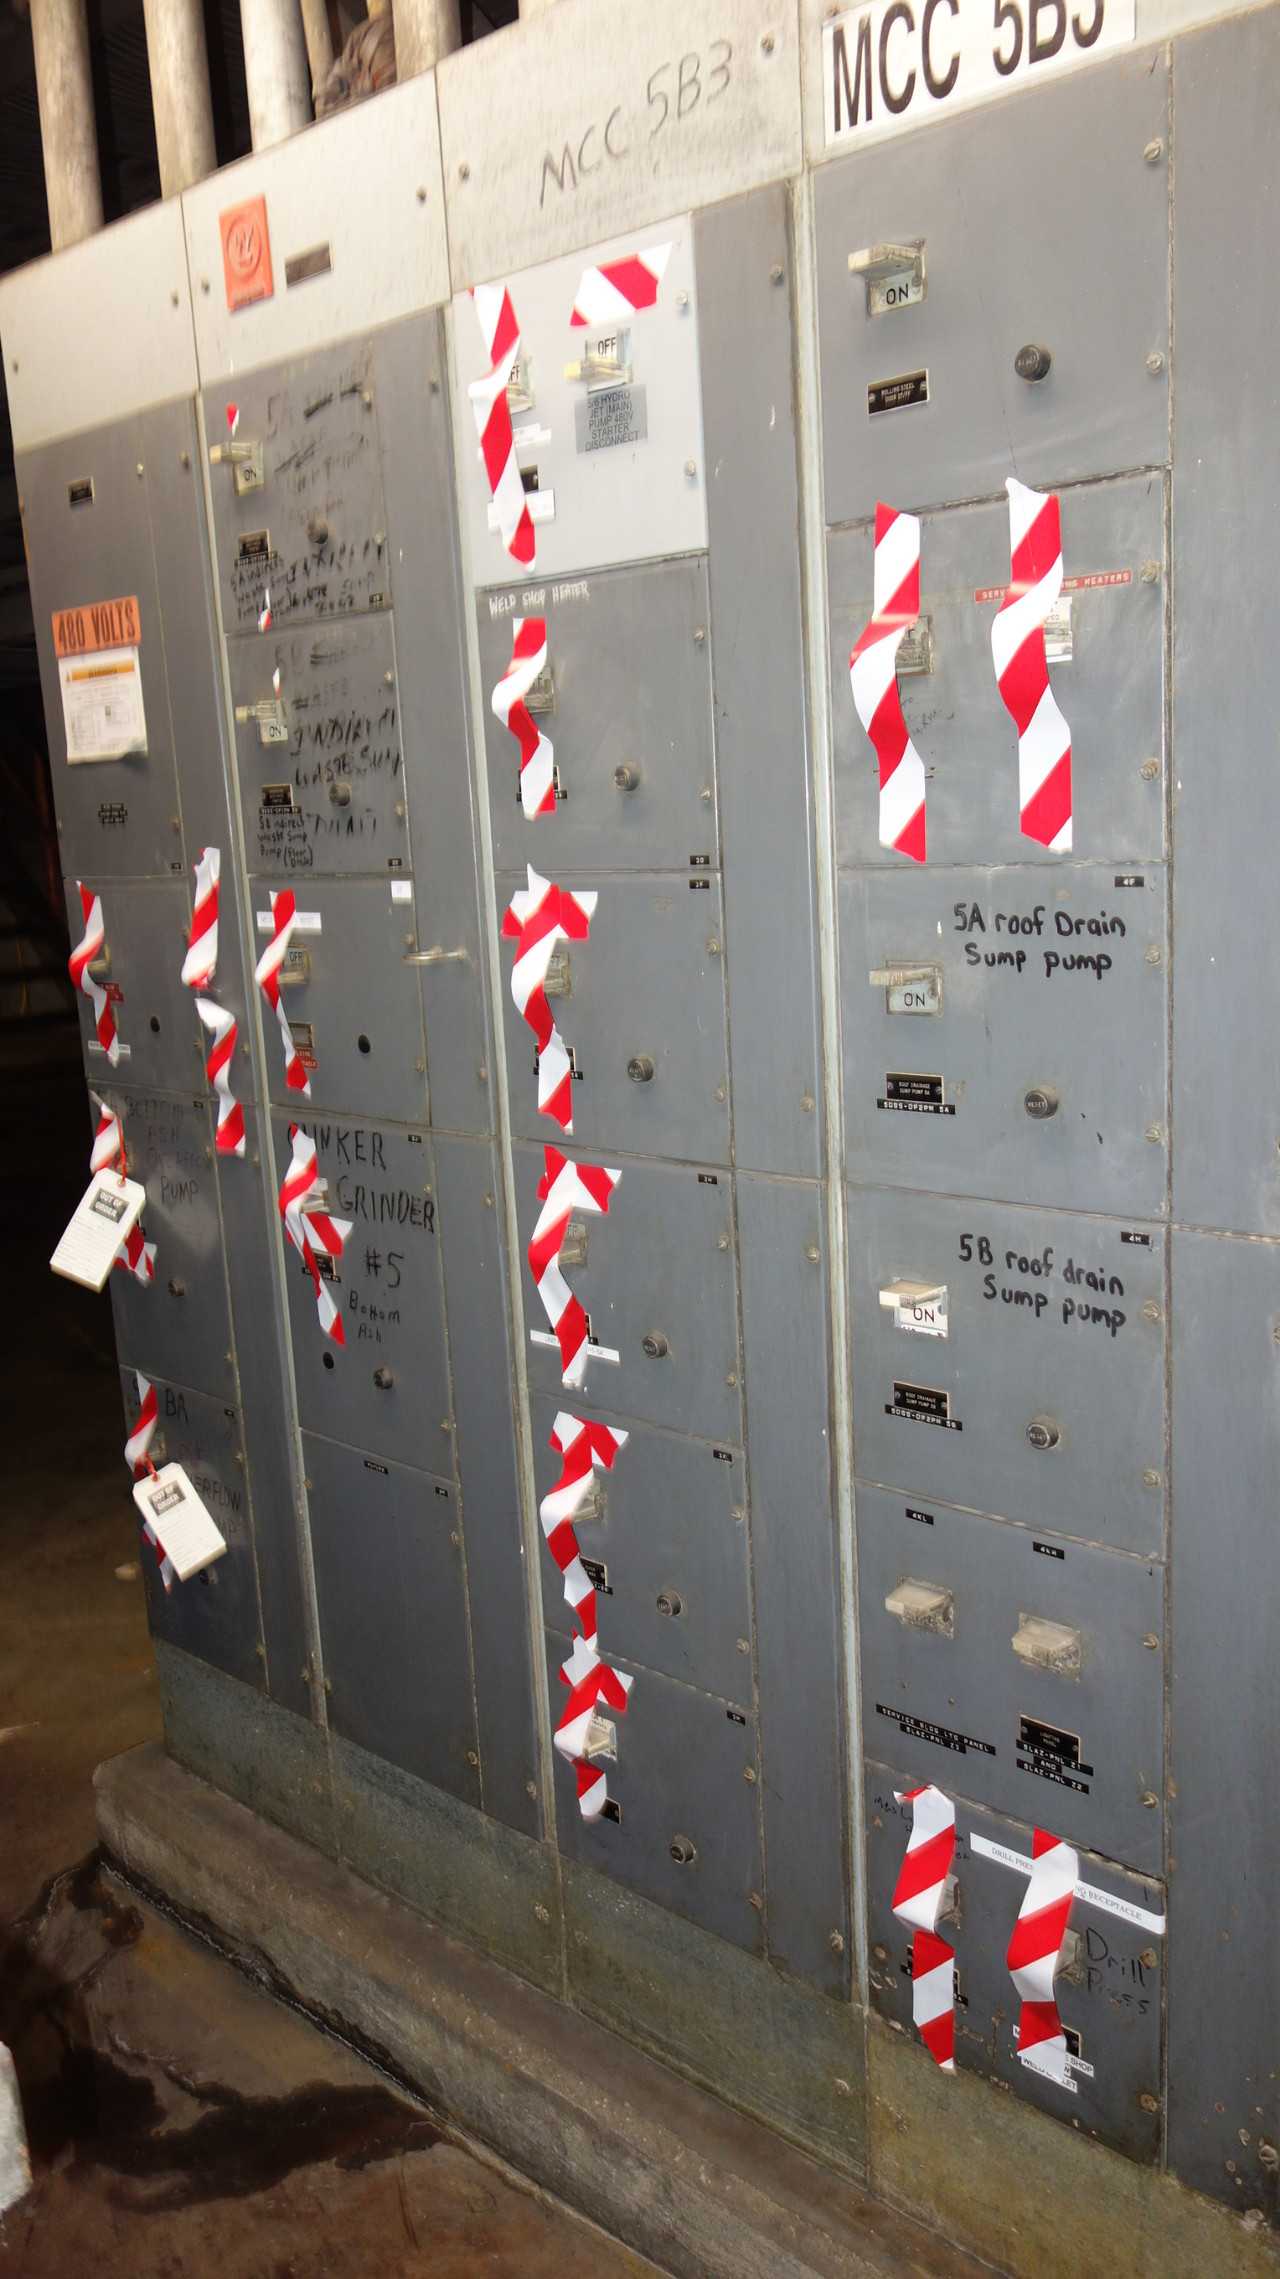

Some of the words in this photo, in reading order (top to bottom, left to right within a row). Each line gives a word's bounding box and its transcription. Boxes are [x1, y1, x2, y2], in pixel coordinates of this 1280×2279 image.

[832, 0, 961, 132] MCC
[540, 104, 629, 209] MCC
[647, 38, 733, 139] 5B3
[886, 283, 909, 305] ON
[597, 336, 617, 356] OFF
[590, 406, 604, 419] JET
[607, 403, 633, 415] (MAIN)
[601, 390, 631, 404] HYDRO
[588, 415, 612, 431] PUMP
[591, 422, 630, 440] STARTER
[584, 431, 640, 452] DISCONNECT
[1084, 572, 1130, 587] HEATERS
[488, 593, 517, 617] WELD
[522, 588, 546, 609] SHOP
[552, 580, 591, 602] HEATER
[58, 610, 86, 651] 480
[91, 600, 135, 646] VOLTS
[268, 725, 282, 738] ON
[953, 902, 986, 933] 5A
[994, 905, 1046, 936] roof
[1054, 910, 1126, 937] Drain
[964, 942, 1027, 973] Sump
[1043, 950, 1112, 980] pump
[903, 992, 926, 1007] ON
[288, 1123, 387, 1171] INKER
[336, 1175, 435, 1234] GRINDER
[366, 1248, 405, 1289] #5
[958, 1233, 994, 1266] 5B
[1006, 1247, 1053, 1278] roof
[1063, 1258, 1125, 1296] drain
[350, 1290, 401, 1323] Bottom
[913, 1307, 935, 1323] ON
[983, 1273, 1048, 1318] Sump
[1062, 1298, 1127, 1338] pump
[882, 1707, 915, 1725] SERVICE
[963, 1737, 989, 1752] PANEL
[1040, 1759, 1057, 1770] AND
[991, 1847, 1014, 1864] DRILL
[1088, 1890, 1142, 1921] RECEPTACLE
[1086, 1927, 1147, 1987] Drill
[1070, 2056, 1093, 2073] SHOP
